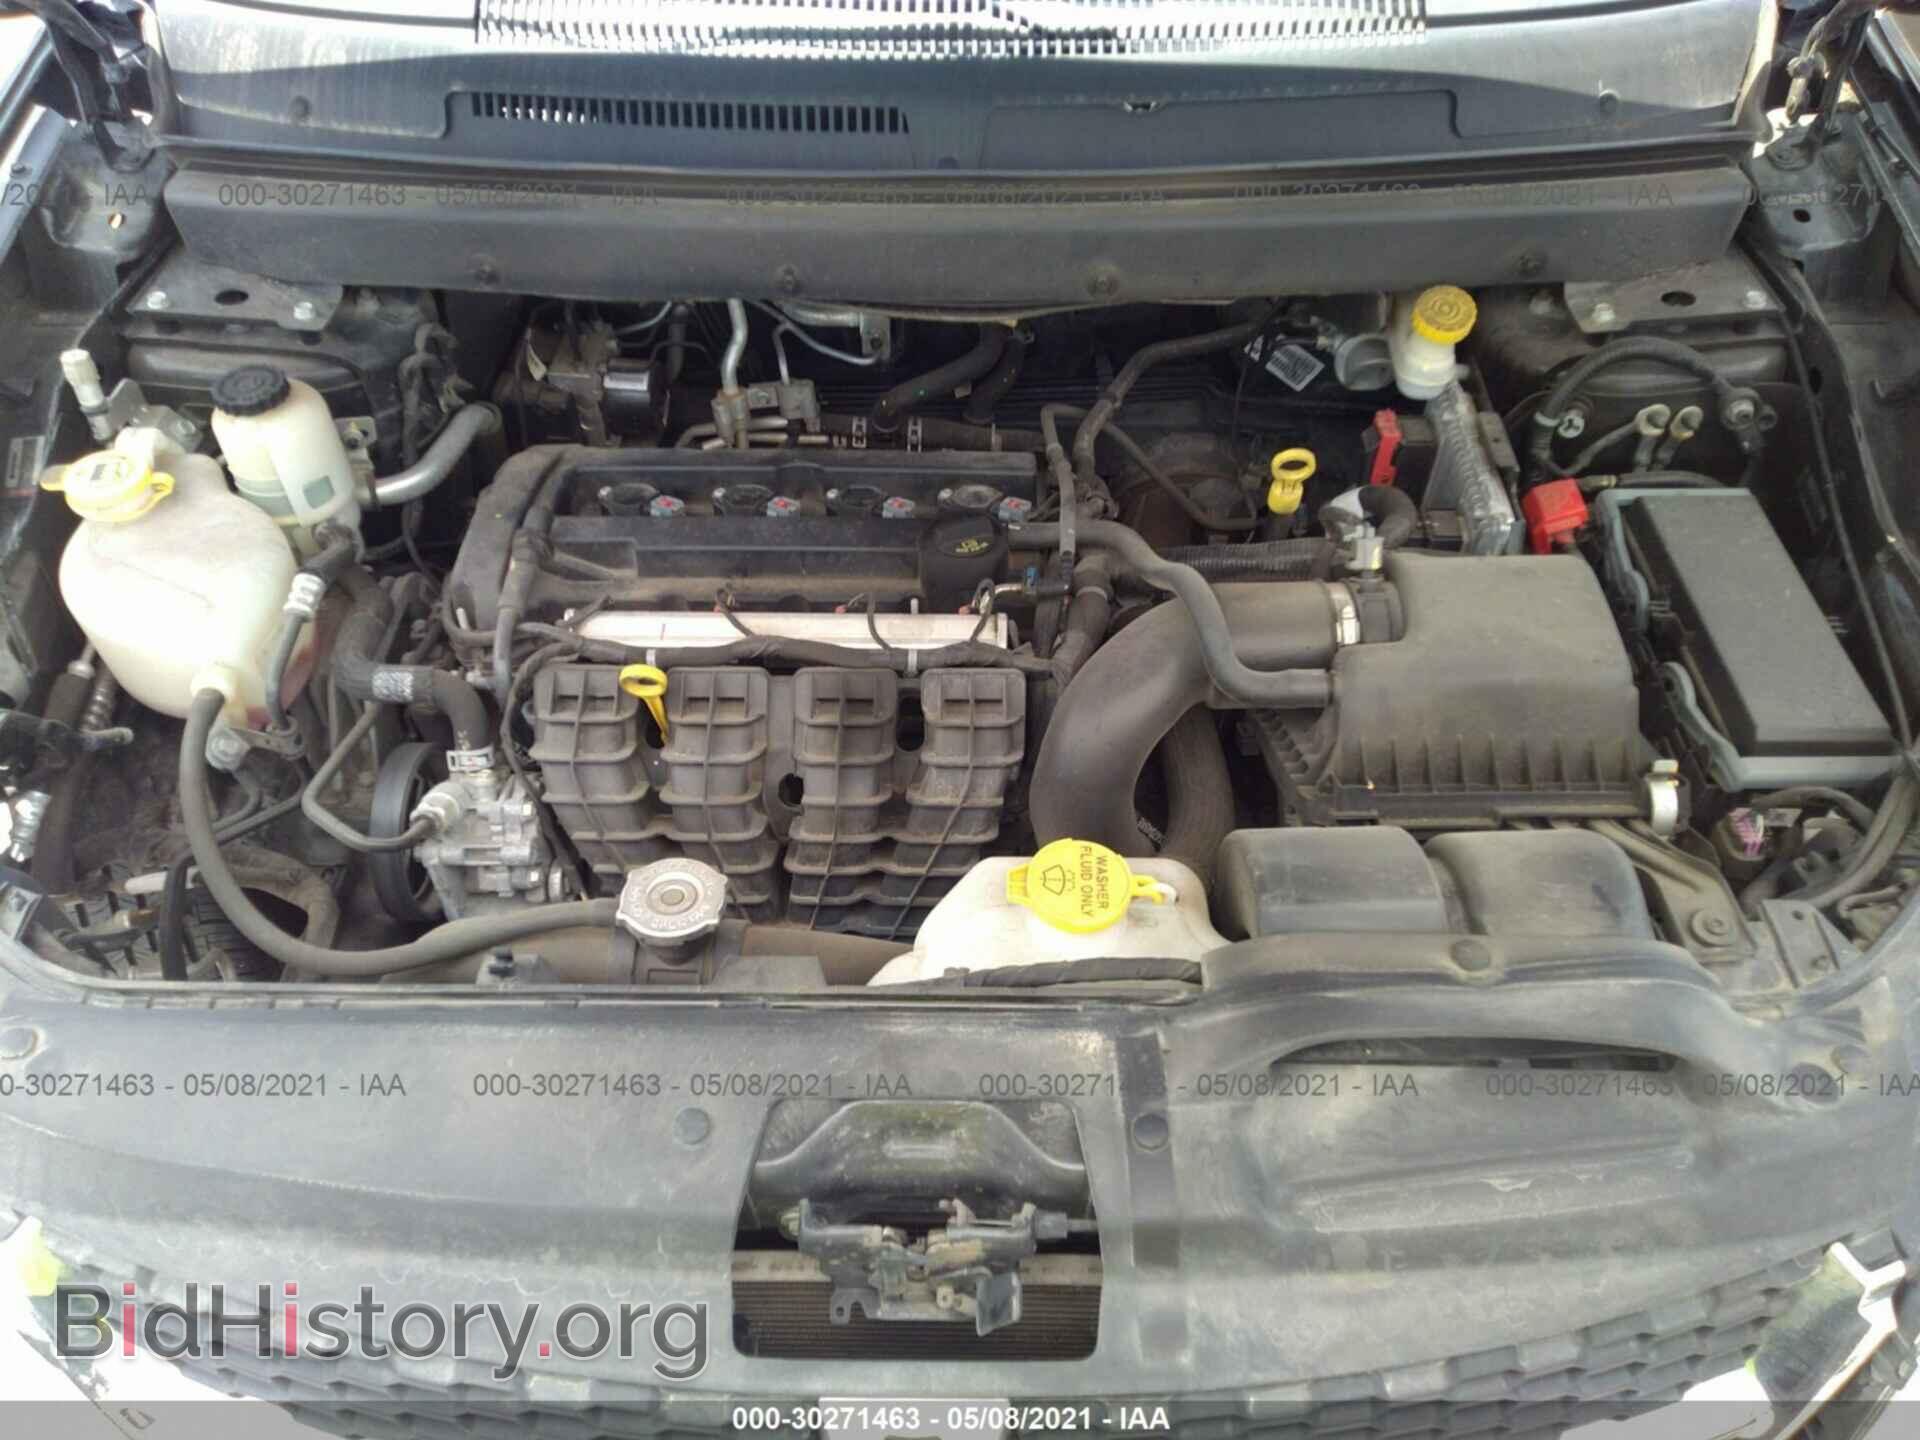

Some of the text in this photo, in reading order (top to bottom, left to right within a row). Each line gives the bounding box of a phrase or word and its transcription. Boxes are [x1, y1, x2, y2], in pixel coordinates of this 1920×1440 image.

[1080, 846, 1094, 917] FLUID ONLY
[1096, 854, 1110, 909] WASHER
